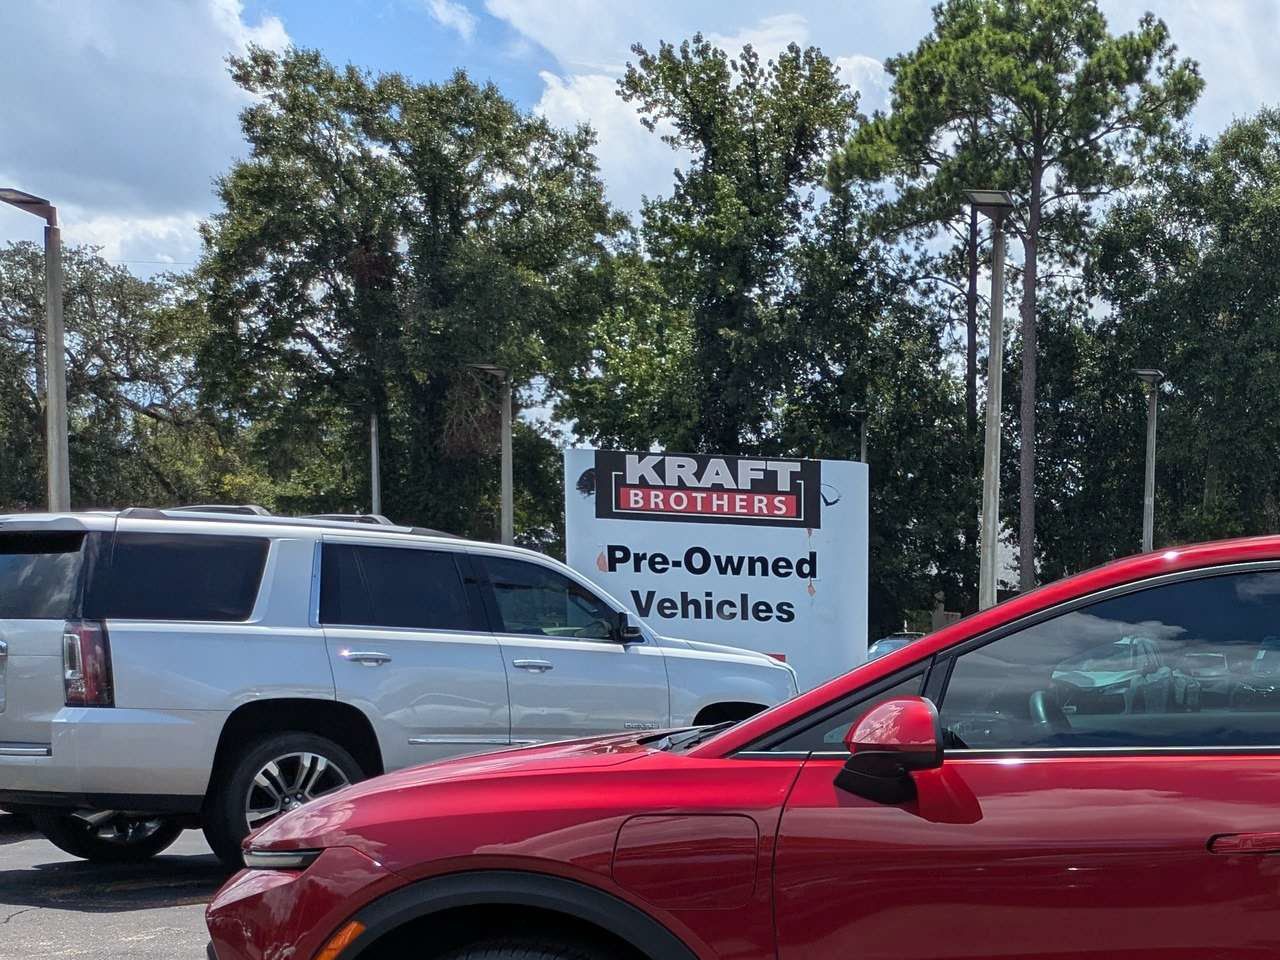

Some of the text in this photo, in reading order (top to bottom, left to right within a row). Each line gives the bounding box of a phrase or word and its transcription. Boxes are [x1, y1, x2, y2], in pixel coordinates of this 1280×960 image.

[625, 455, 801, 491] KRAFT
[629, 489, 788, 515] BROTHERS
[606, 544, 818, 579] Pre-Owned
[630, 590, 796, 624] Vehicles
